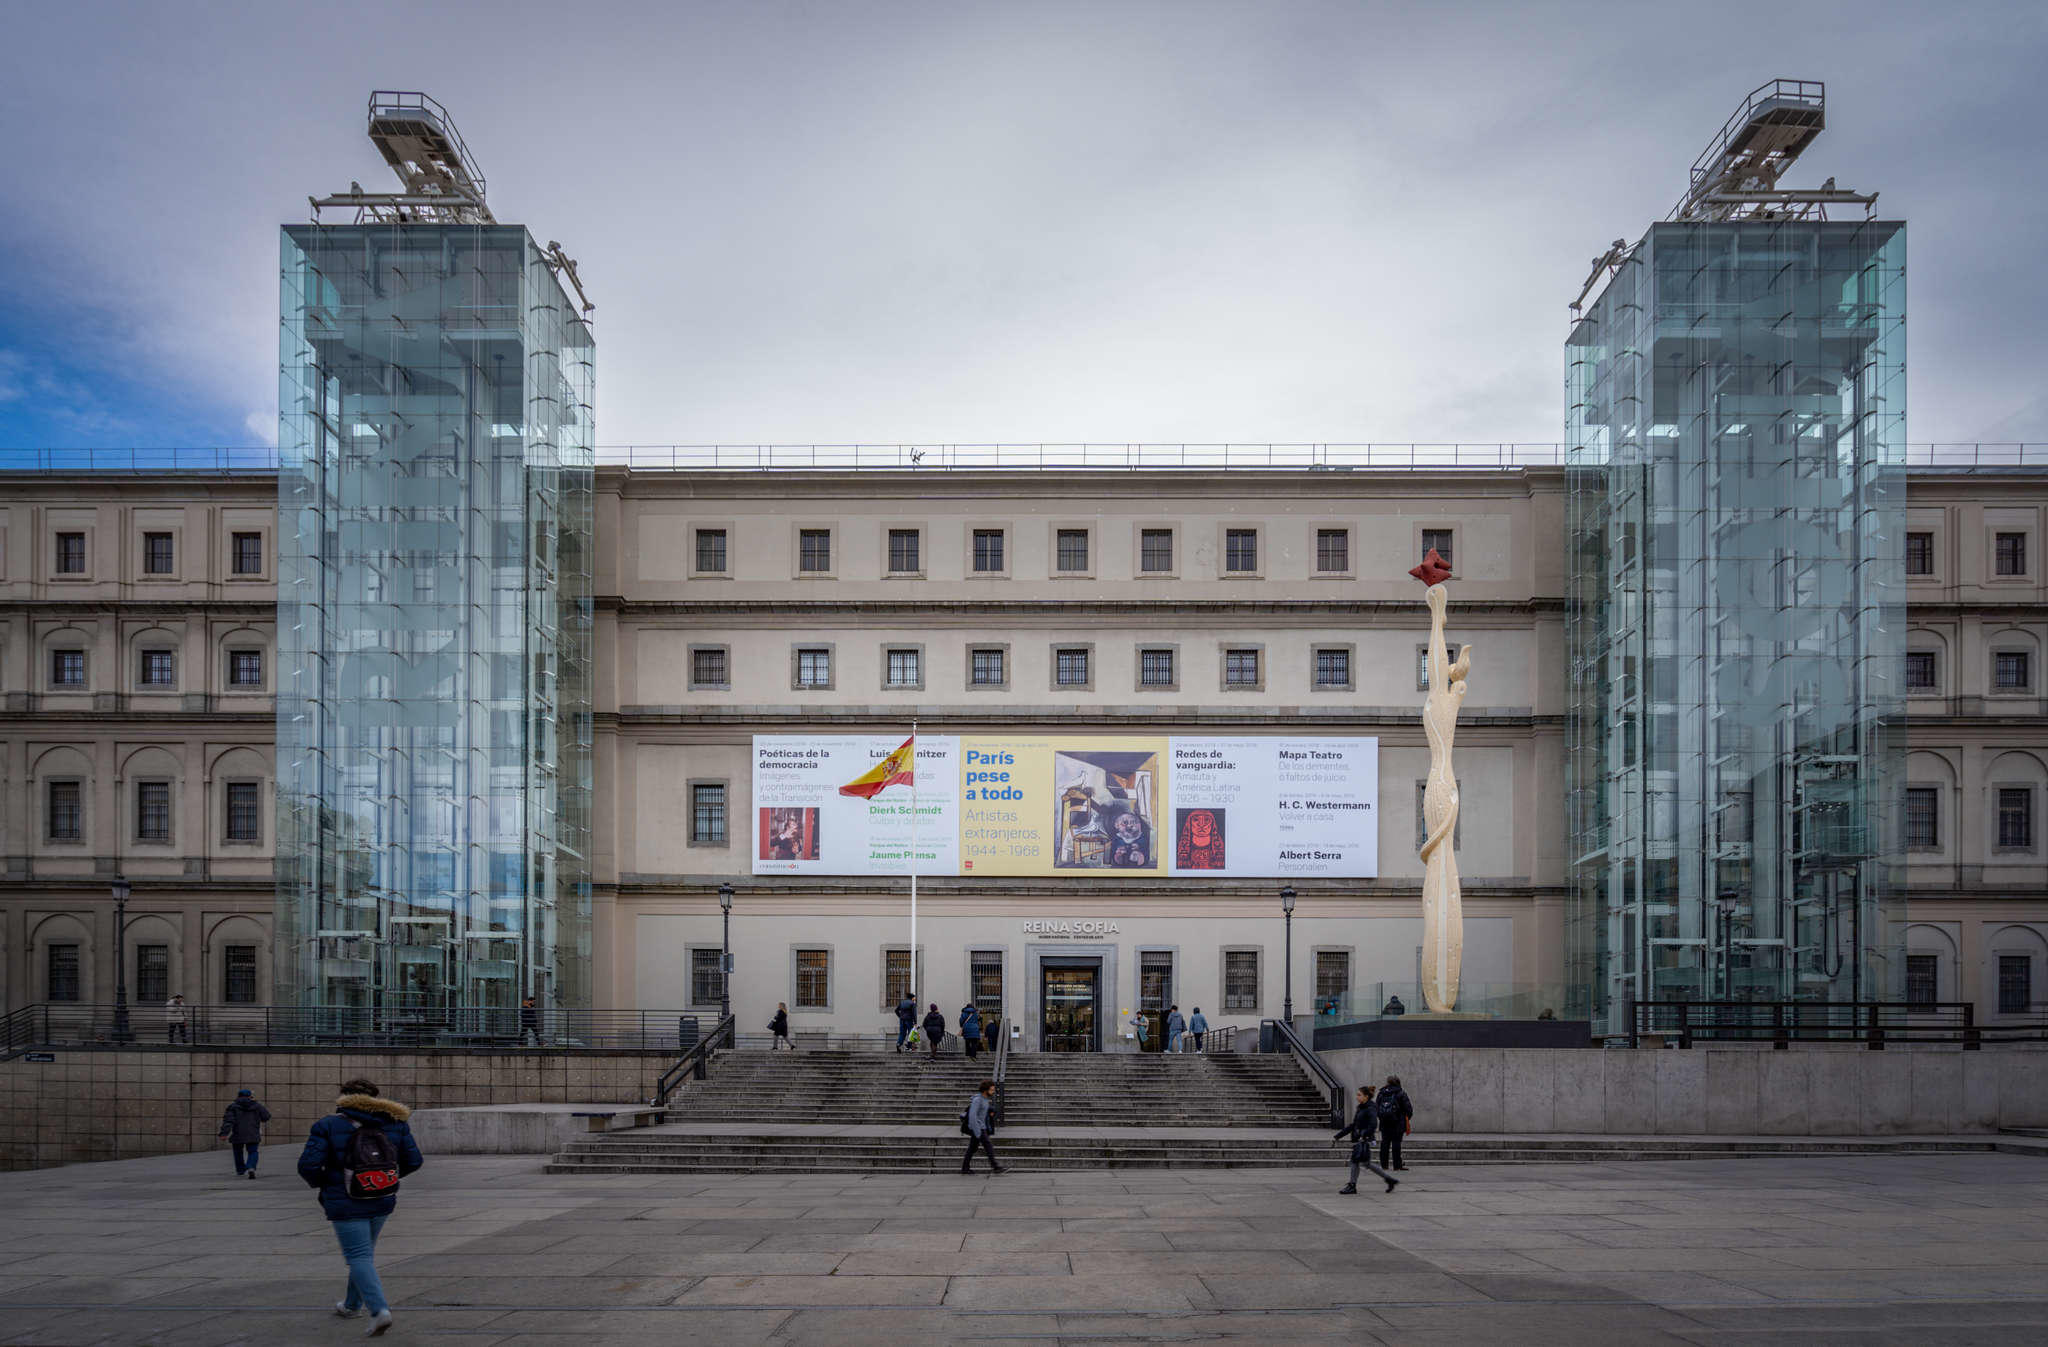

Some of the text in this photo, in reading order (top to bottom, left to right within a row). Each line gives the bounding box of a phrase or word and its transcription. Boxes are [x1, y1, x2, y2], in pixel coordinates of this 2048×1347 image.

[759, 748, 830, 758] Poéticas de la
[870, 749, 890, 758] Luis
[967, 750, 1015, 765] París
[1176, 749, 1223, 759] Redes de
[1279, 750, 1343, 760] Mapa Teatro
[759, 760, 818, 769] democracia
[1176, 760, 1236, 771] vanguardia:
[966, 771, 1010, 786] pese
[966, 785, 1023, 800] a todo
[1279, 800, 1371, 810] H. C. Westermann
[869, 806, 942, 815] Dierk Schmidt
[965, 809, 1018, 821] Artistas
[869, 851, 902, 859] Jaume
[964, 845, 997, 856] 1944
[1008, 845, 1040, 856] 1968
[1279, 850, 1342, 859] Albert Serra
[1023, 920, 1120, 933] REINA SOFIA
